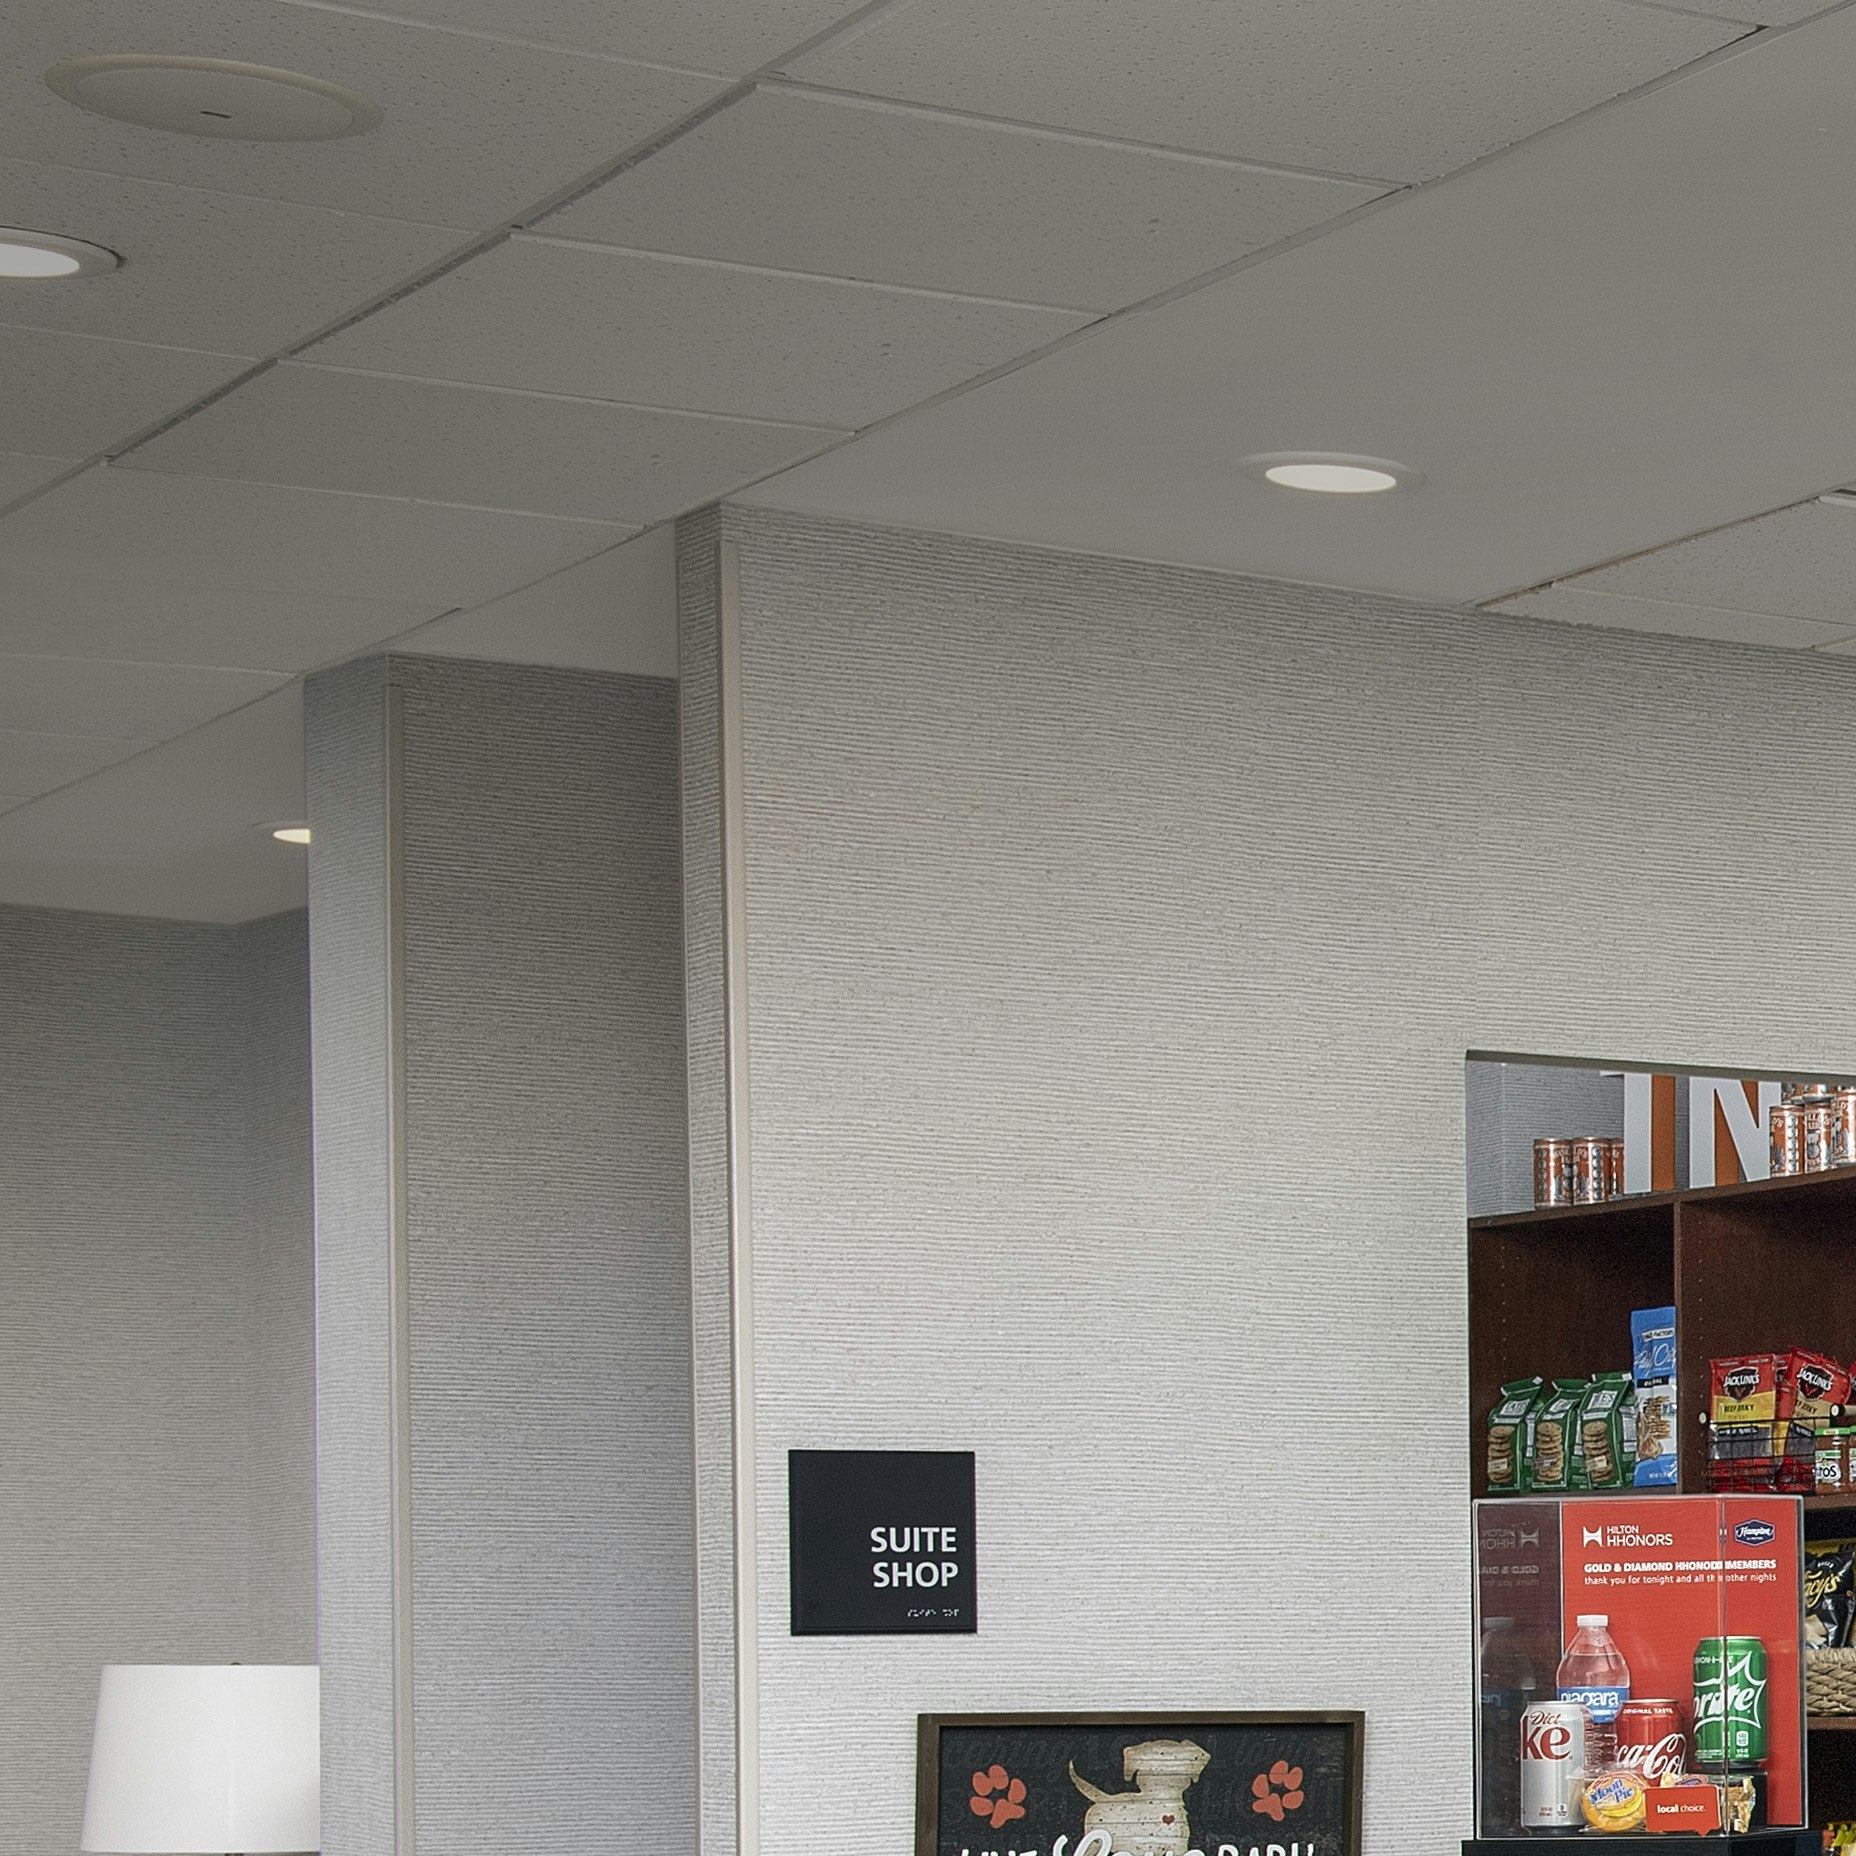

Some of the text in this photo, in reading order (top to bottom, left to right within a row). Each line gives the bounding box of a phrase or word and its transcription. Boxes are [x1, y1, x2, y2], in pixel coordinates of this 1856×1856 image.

[1607, 1525, 1639, 1534] HILTON
[870, 1527, 957, 1553] SUITE
[1607, 1534, 1674, 1547] HHONORS
[1584, 1563, 1612, 1573] GOLD
[1614, 1563, 1622, 1572] &
[1624, 1562, 1672, 1573] DIAMOND
[1728, 1559, 1777, 1570] MEMBERS
[873, 1562, 959, 1588] SHOP
[1584, 1576, 1608, 1585] thank
[1610, 1577, 1626, 1587] you
[1628, 1575, 1640, 1584] for
[1643, 1575, 1674, 1586] tonight
[1676, 1574, 1692, 1583] and
[1694, 1574, 1705, 1583] all
[1725, 1573, 1748, 1582] other
[1751, 1572, 1777, 1584] nights
[1530, 1710, 1562, 1725] Diet
[1522, 1714, 1571, 1760] ke
[1657, 1804, 1707, 1813] local choice.
